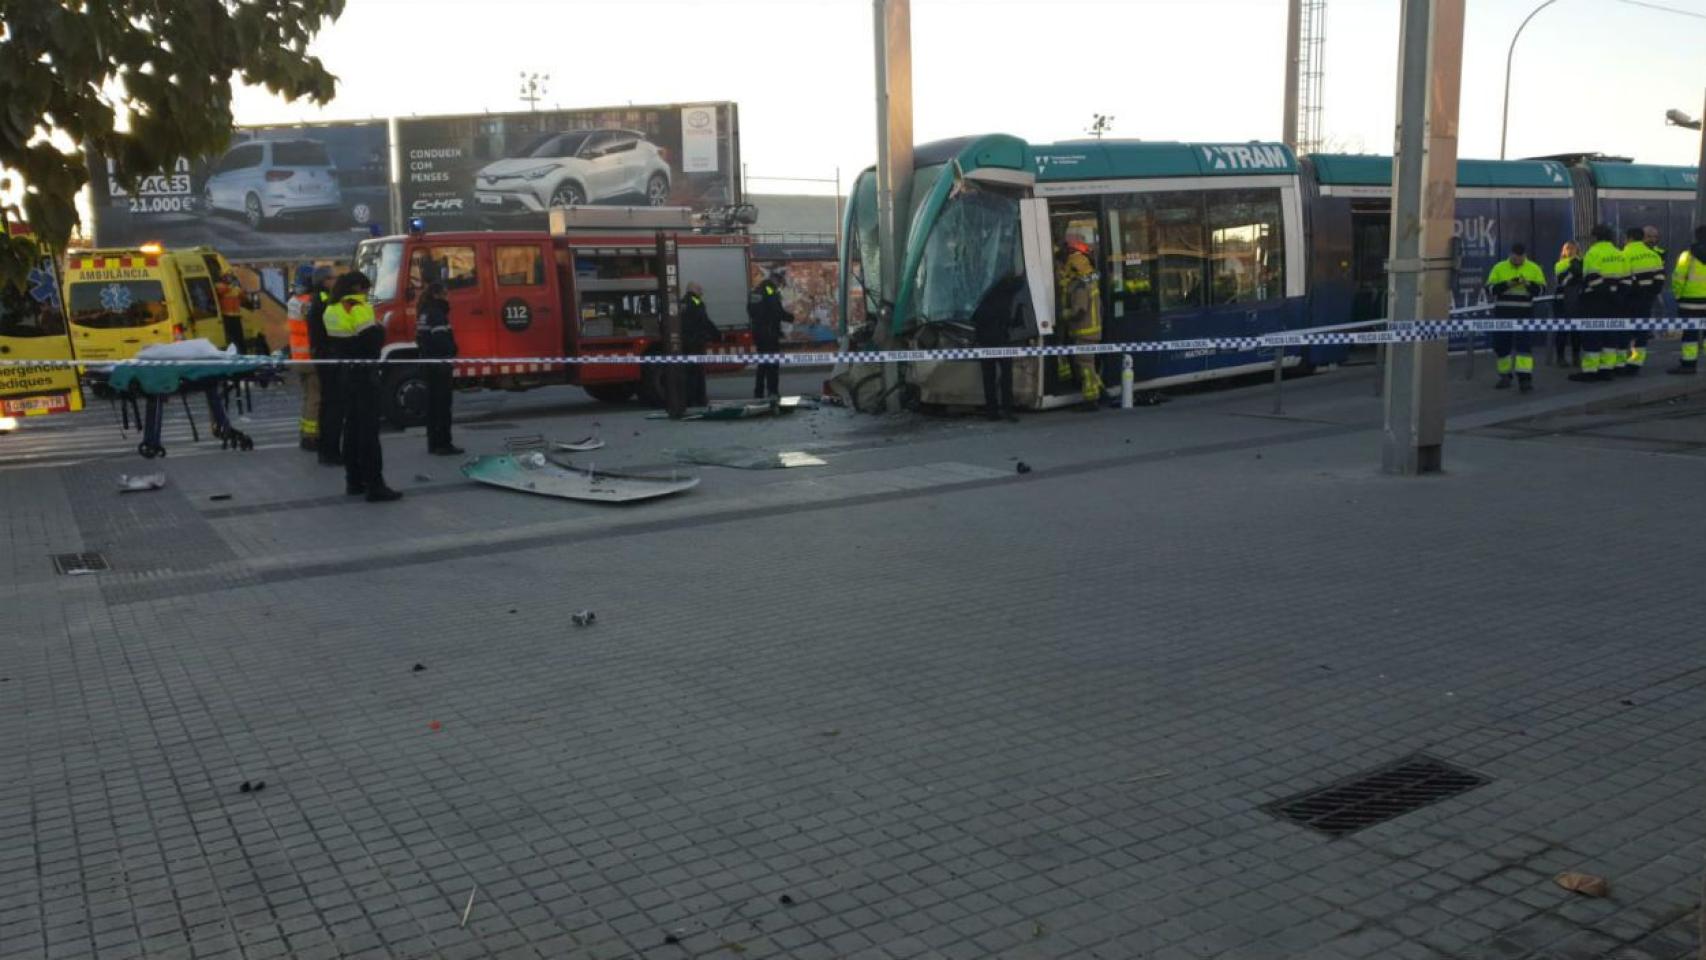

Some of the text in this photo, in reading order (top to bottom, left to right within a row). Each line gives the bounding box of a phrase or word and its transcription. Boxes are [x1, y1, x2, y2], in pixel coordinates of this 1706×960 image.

[410, 149, 462, 159] CONDUEIX
[1221, 146, 1288, 169] TRAM
[410, 160, 433, 171] COM
[411, 172, 449, 182] PENSES
[412, 199, 463, 210] C-HR
[506, 306, 528, 319] 112
[1472, 320, 1513, 329] POLICIA LOCAL
[1581, 320, 1626, 328] POLICIA LOCAL
